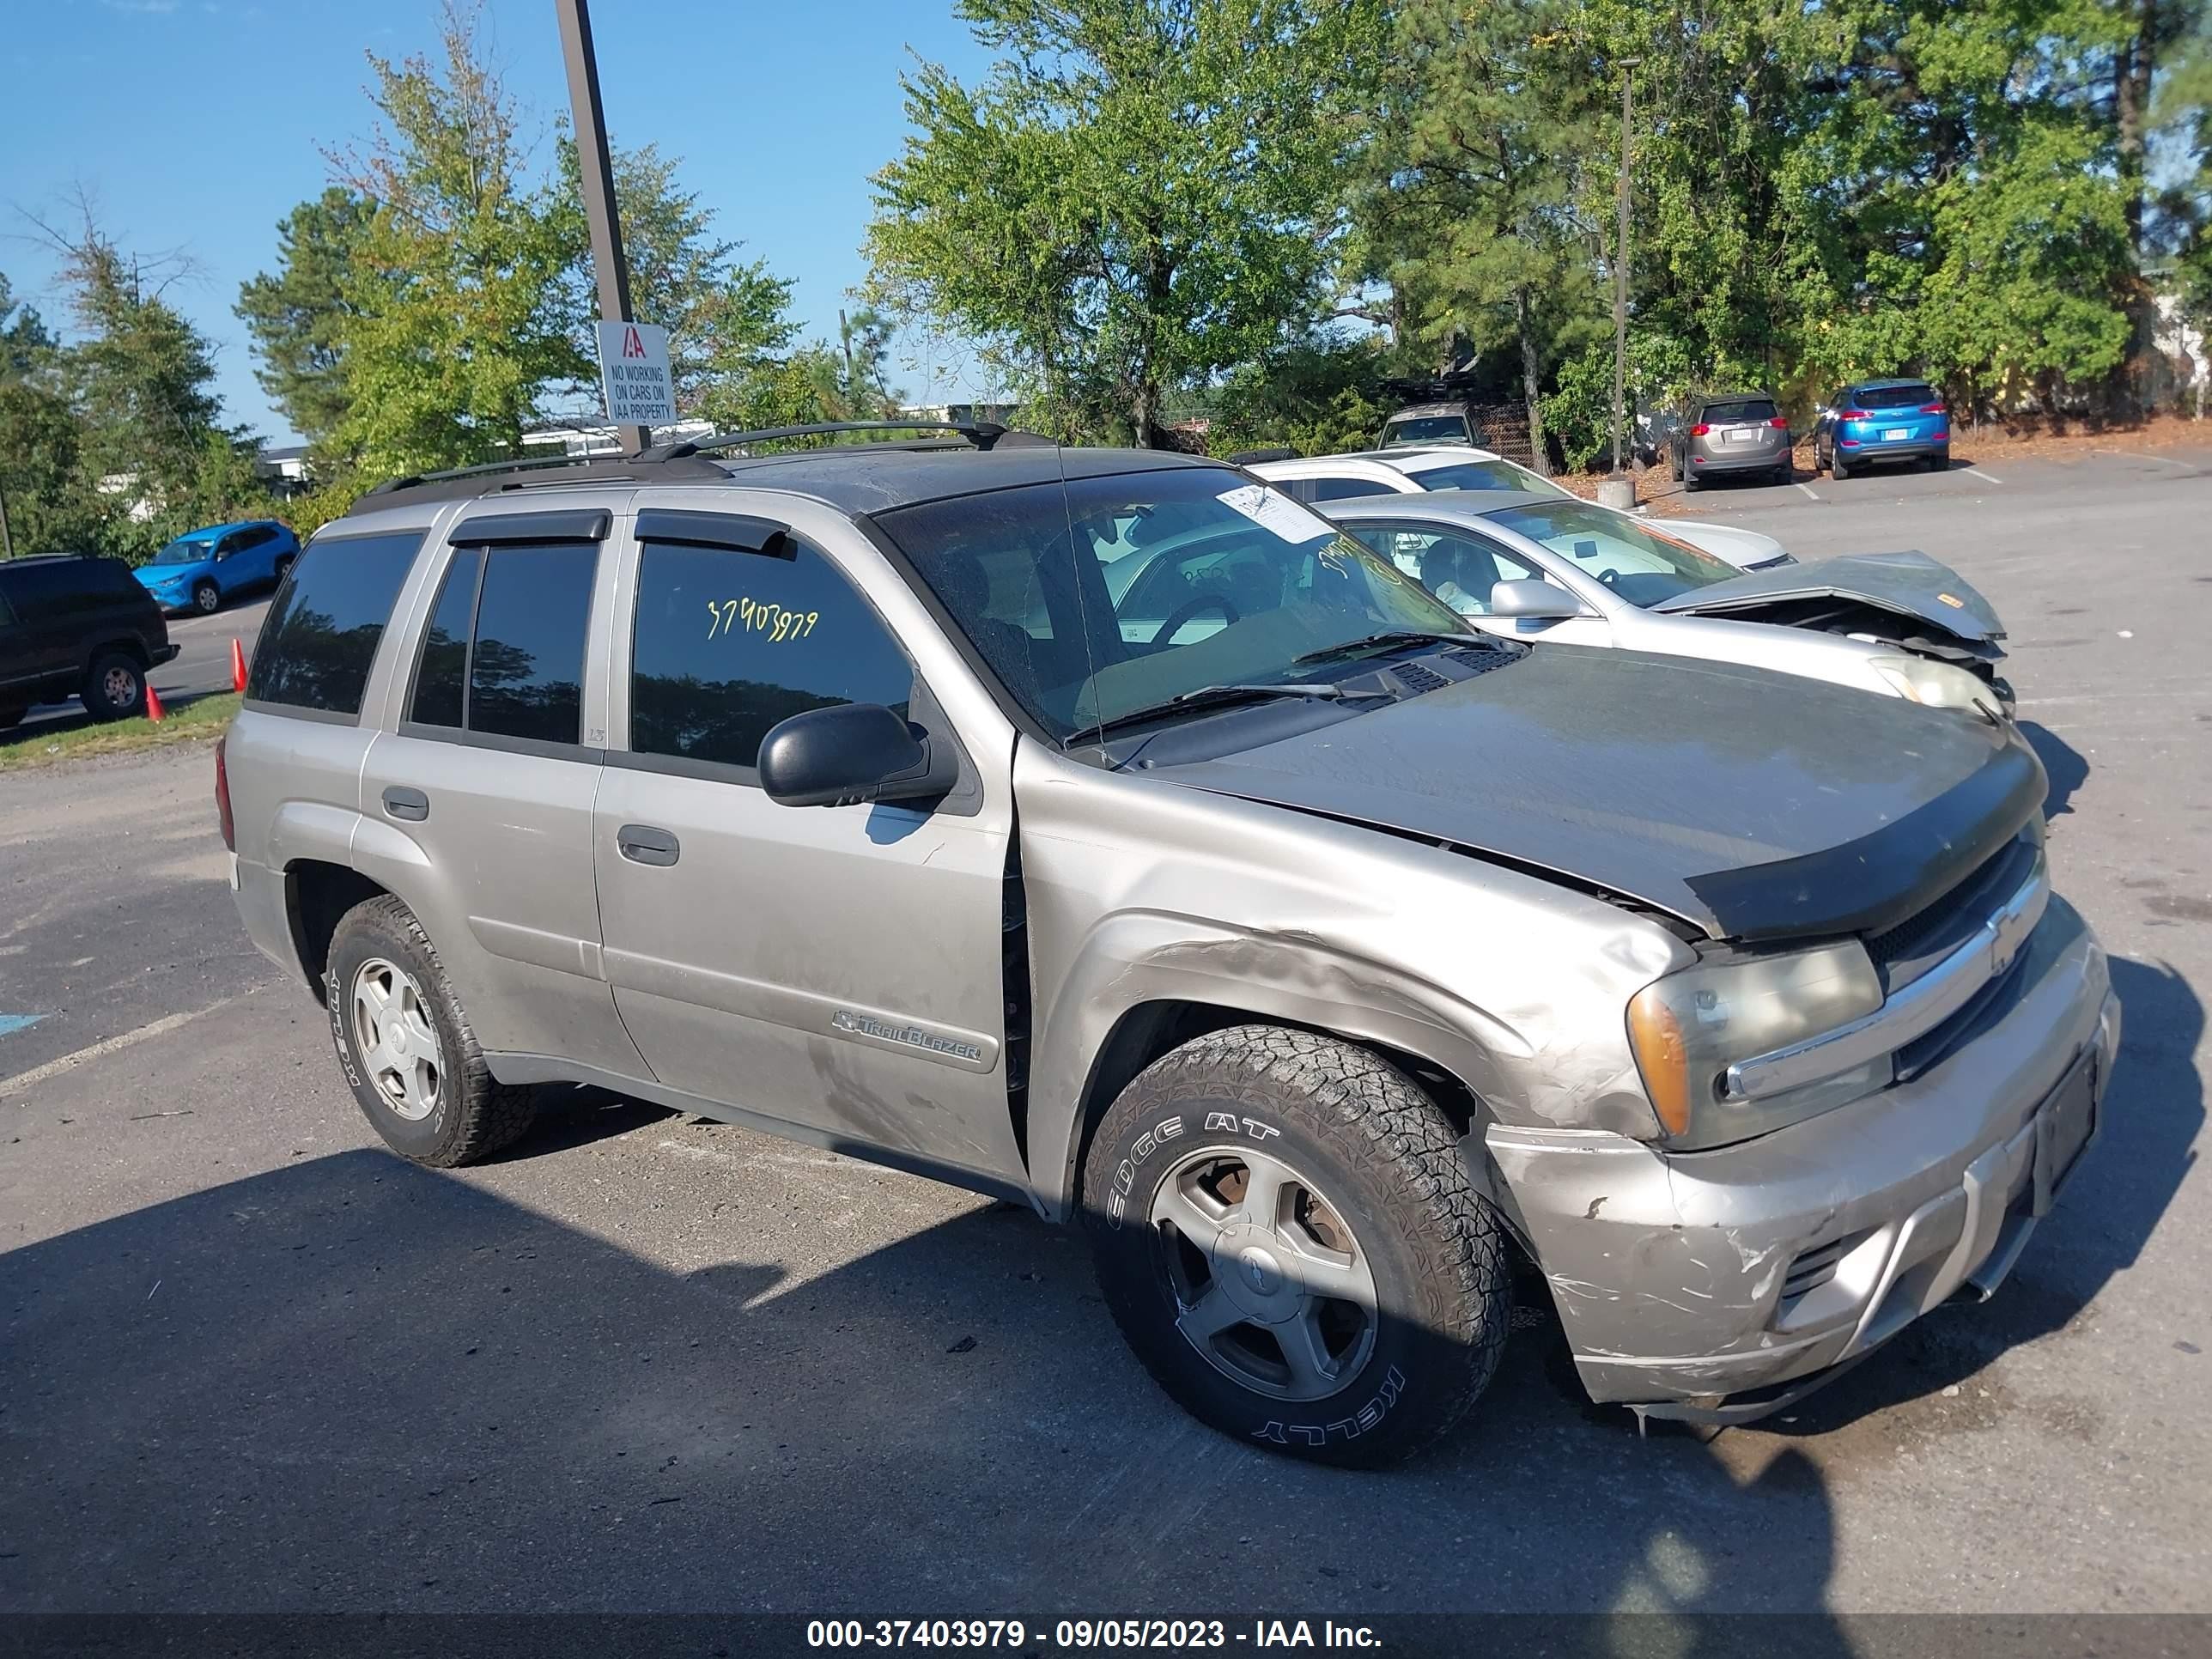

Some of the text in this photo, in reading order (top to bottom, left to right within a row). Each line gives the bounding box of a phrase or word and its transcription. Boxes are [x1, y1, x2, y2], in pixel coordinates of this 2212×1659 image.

[611, 365, 663, 382] NO WORKING
[616, 385, 665, 401] ON CARS ON
[614, 404, 670, 420] IAA PROPERTY
[331, 968, 361, 1087] KELLY
[1107, 1112, 1280, 1231] EDGE AT
[1252, 1365, 1407, 1447] KELLY
